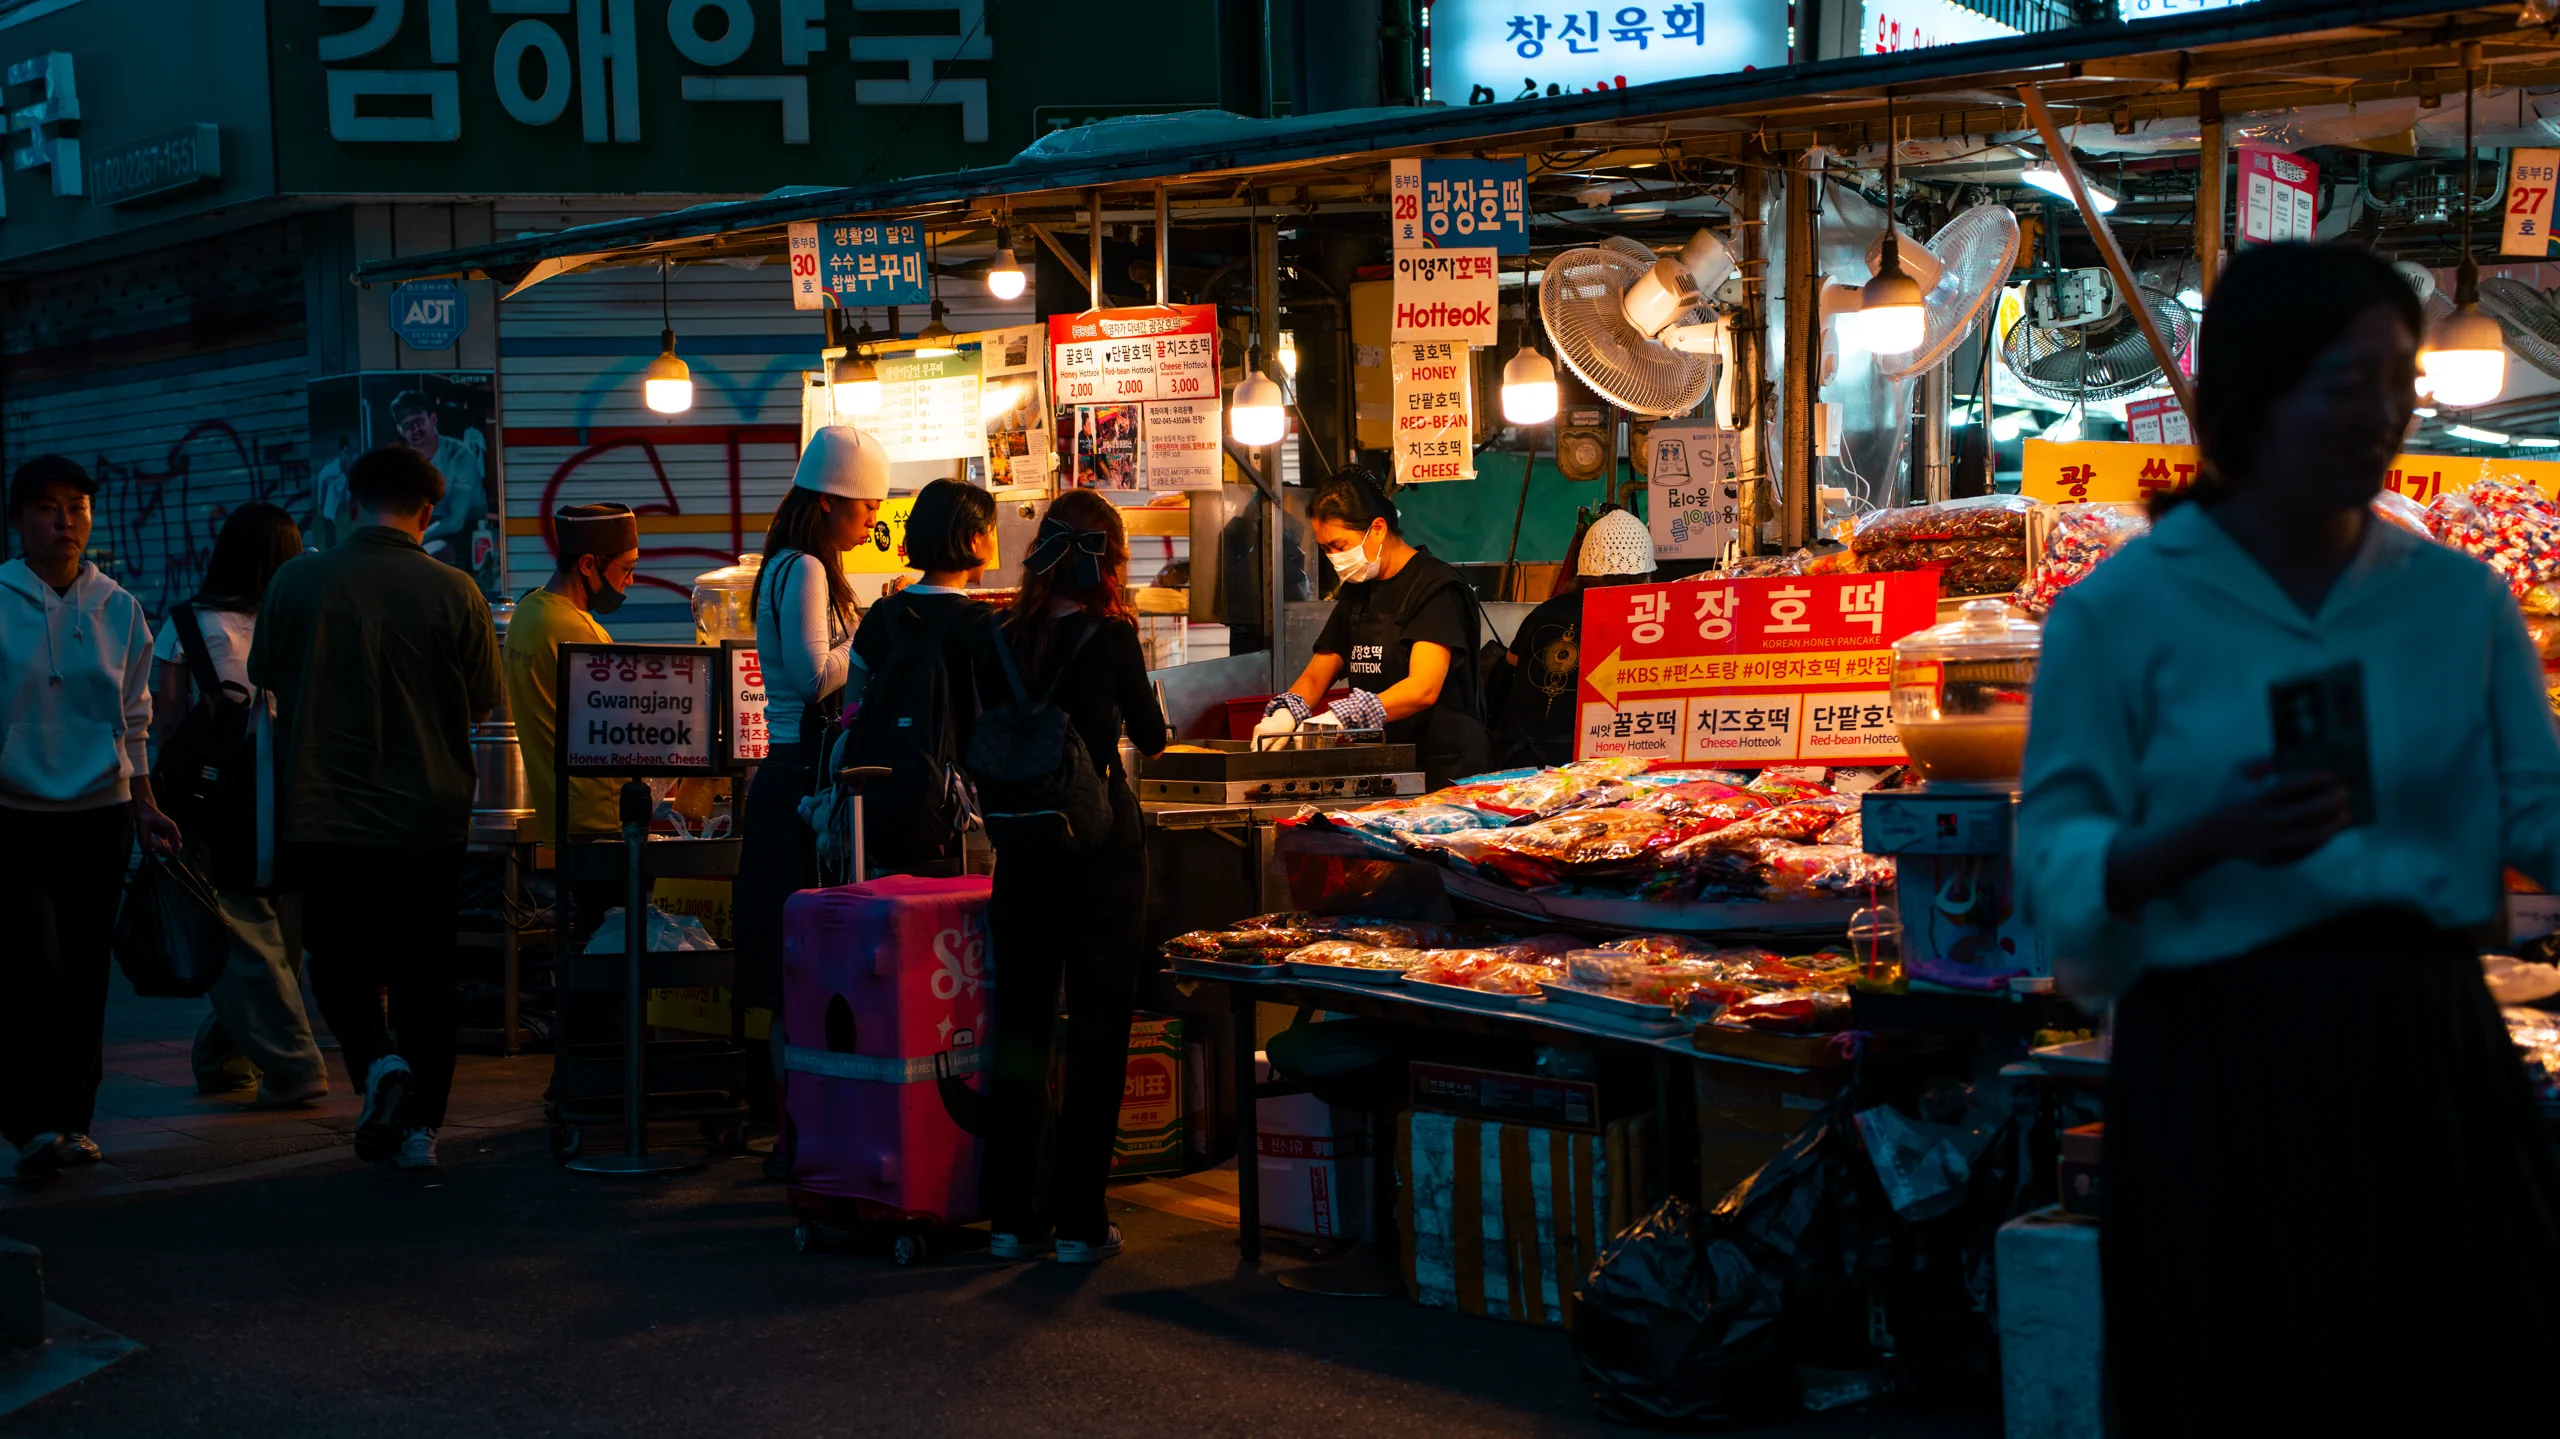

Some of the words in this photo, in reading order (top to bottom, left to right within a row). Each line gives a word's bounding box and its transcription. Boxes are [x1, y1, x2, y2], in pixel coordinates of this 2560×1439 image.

[1505, 1, 1705, 59] 창신육회
[318, 0, 993, 144] 김해약국
[1395, 175, 1419, 188] 동부B
[2516, 166, 2554, 181] 동부B
[1395, 194, 1417, 219] 28
[1427, 179, 1523, 235] 광장호떡
[2510, 187, 2548, 214] 27
[834, 227, 878, 246] 생활의
[885, 226, 915, 245] 달인
[1403, 224, 1414, 239] 호
[2518, 219, 2536, 236] 호
[792, 237, 816, 249] 동부B
[793, 254, 816, 276] 30
[857, 252, 922, 291] 부꾸미
[802, 280, 813, 293] 호
[404, 300, 455, 325] ADT
[1397, 301, 1491, 328] Hotteok
[1149, 317, 1181, 333] 광장호떡
[1112, 343, 1151, 362] 단팥호떡
[1156, 337, 1210, 358] 꿀치즈호떡
[1413, 344, 1451, 361] 꿀호떡
[1066, 347, 1093, 366] 꿀호떡
[1160, 361, 1181, 371] Cheese
[1183, 359, 1208, 370] Hotteok
[1060, 370, 1077, 380] Honey
[1079, 368, 1099, 378] Hotteok
[1105, 367, 1130, 376] Red-bean
[1131, 364, 1155, 374] Hotteok
[1411, 366, 1457, 381] HONEY
[1070, 383, 1093, 397] 2,000
[1117, 380, 1143, 395] 2,000
[1172, 378, 1199, 395] 3,000
[1409, 392, 1461, 410] 단팥호떡
[1400, 414, 1468, 430] RED-BEAN
[1409, 440, 1461, 458] 치즈호떡
[1412, 463, 1460, 478] CHEESE
[1669, 487, 1710, 508] 종이컵
[1762, 638, 1801, 649] KOREAN
[1803, 637, 1836, 648] HONEY
[1837, 635, 1881, 646] PANCAKE
[1350, 662, 1381, 673] HOTTEOK
[1616, 667, 1659, 684] #KBS
[1663, 663, 1739, 684] #편스토랑
[1743, 657, 1841, 680] #이영자호떡
[588, 690, 692, 714] Gwangjang
[1589, 724, 1610, 738] 씨앗
[1613, 709, 1677, 738] 꿀호떡
[1697, 706, 1790, 735] 치즈호떡
[588, 720, 692, 745] Hotteok
[1810, 732, 1862, 747] Red-bean
[1863, 730, 1901, 745] Hotteo
[1595, 740, 1627, 753] Honey
[1628, 738, 1667, 751] Hotteok
[1700, 735, 1738, 749] Cheese
[1739, 734, 1782, 748] Hotteok
[667, 753, 708, 765] Cheese
[1130, 1111, 1158, 1122] 식용유
